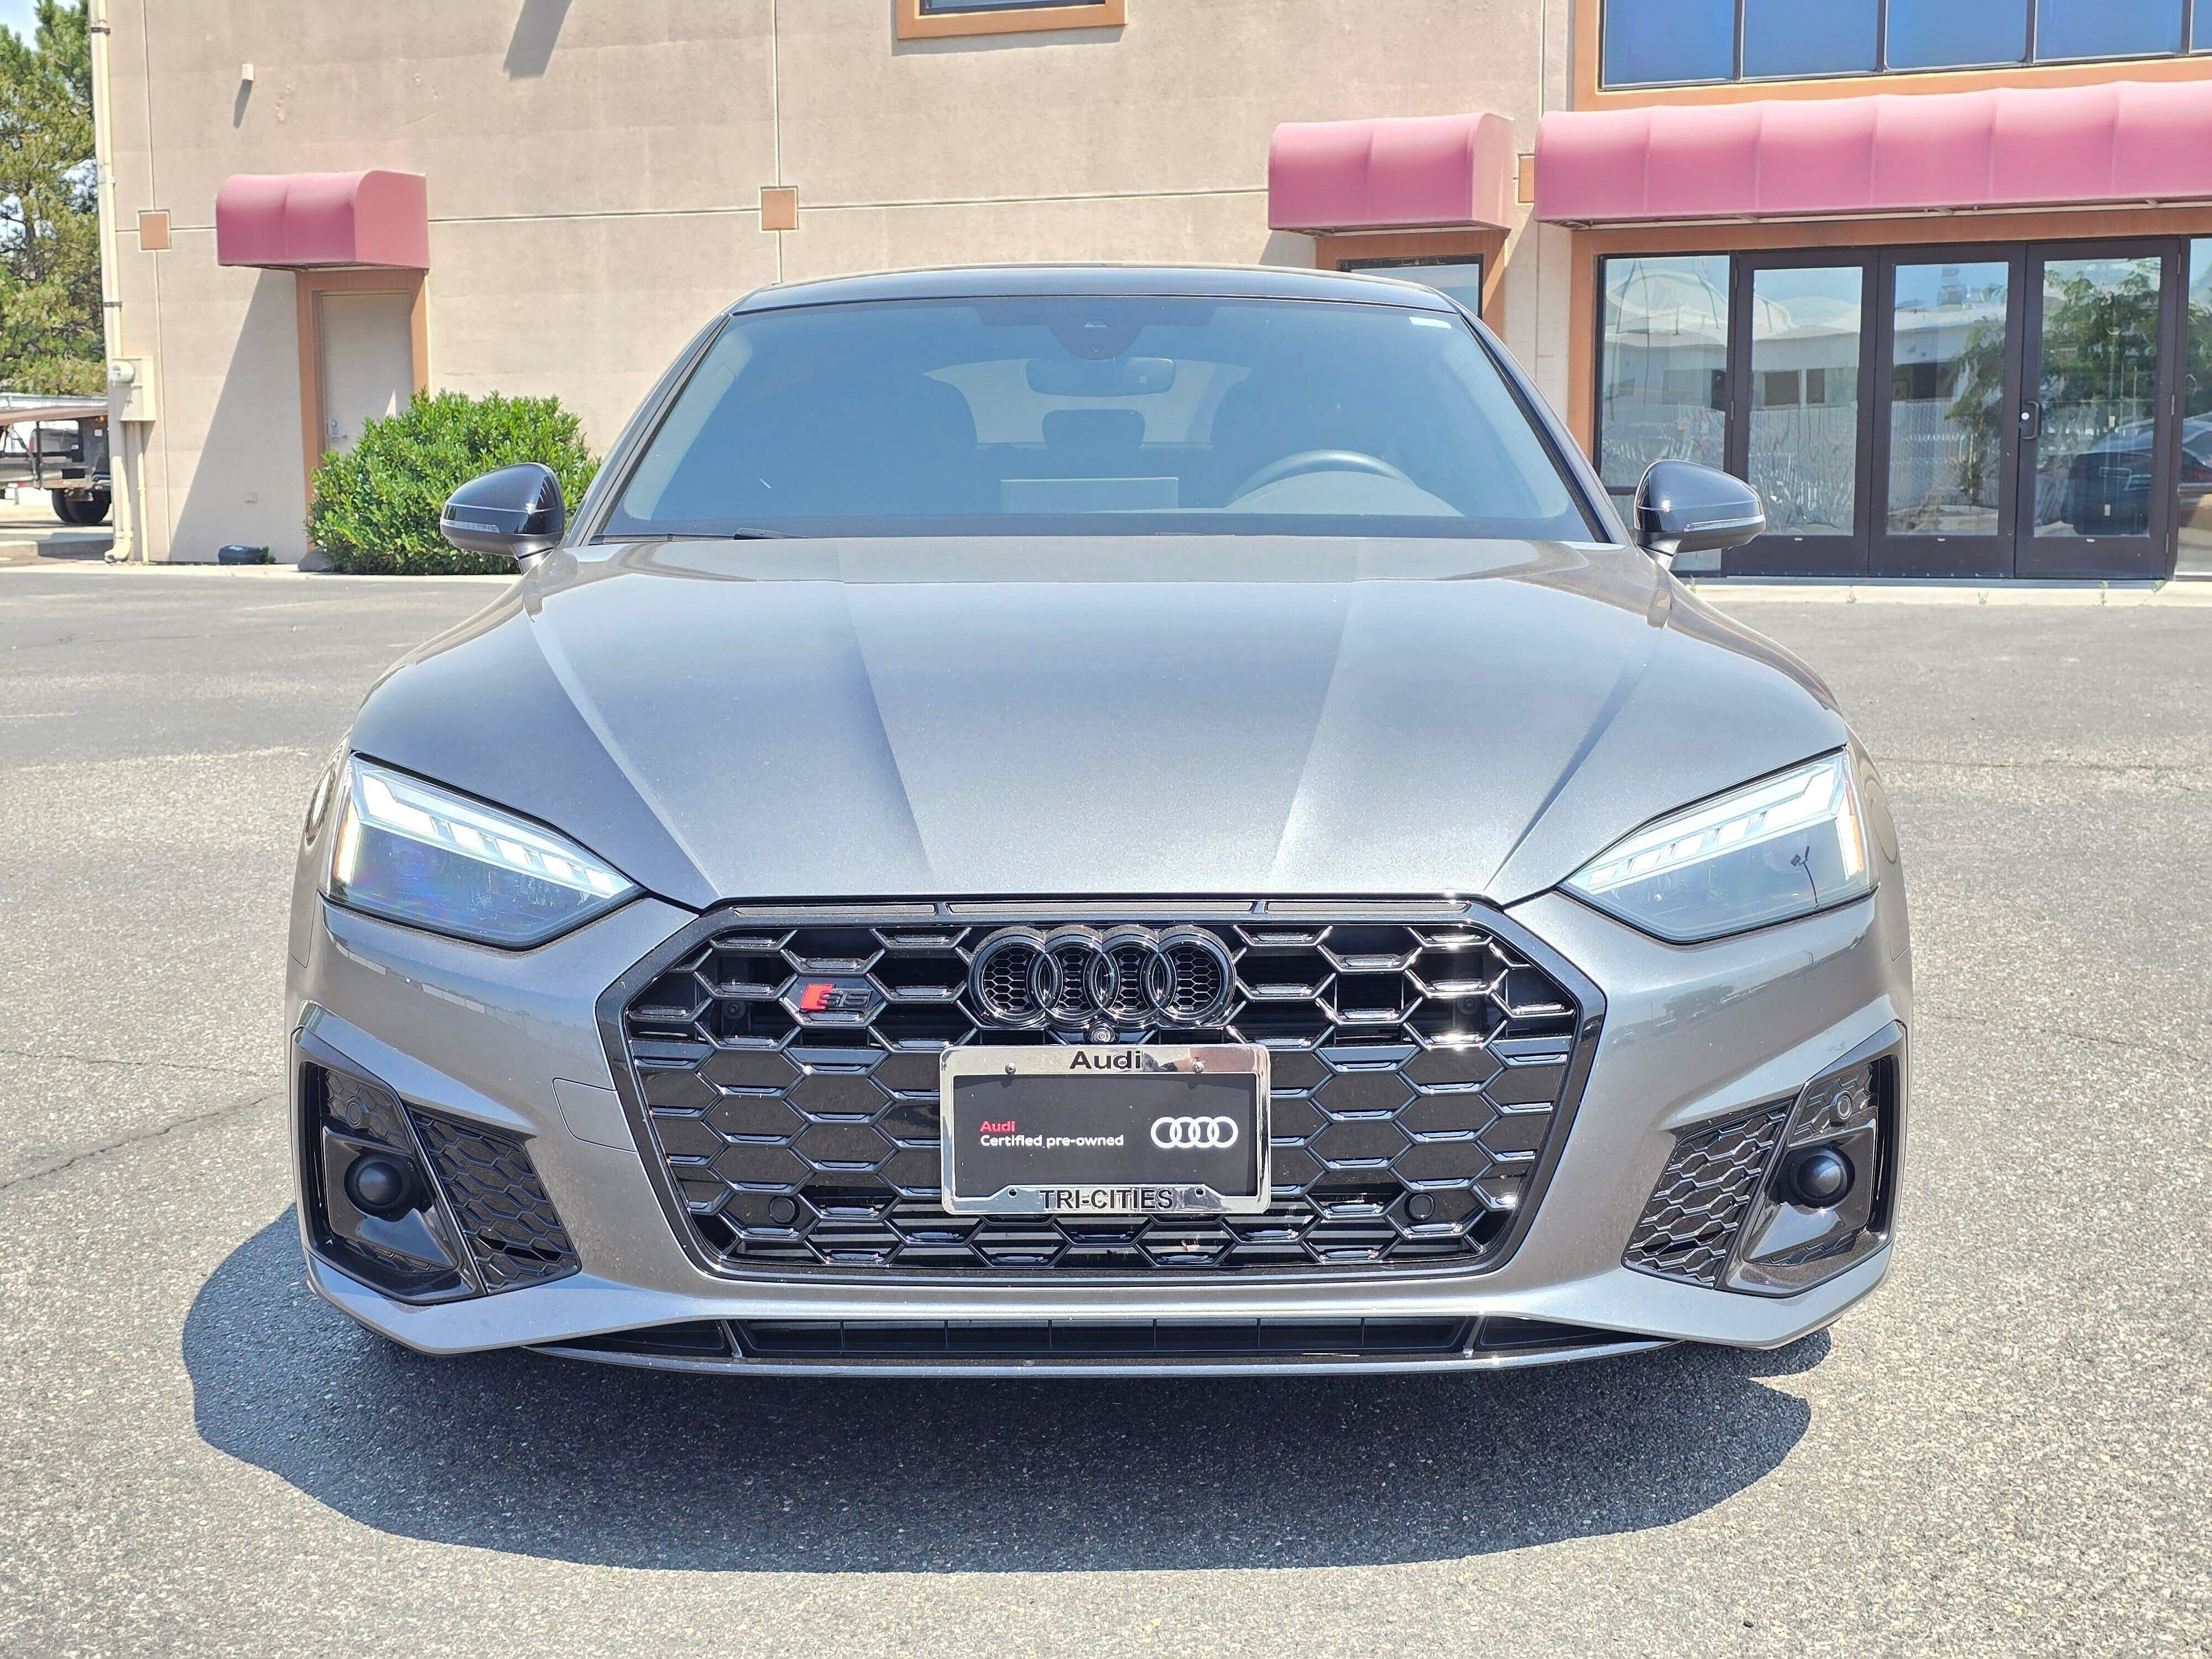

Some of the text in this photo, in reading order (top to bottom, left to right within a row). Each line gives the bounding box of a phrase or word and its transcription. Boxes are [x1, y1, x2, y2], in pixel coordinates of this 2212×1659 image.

[1069, 1050, 1141, 1070] Audi
[980, 1120, 1016, 1132] Audi
[980, 1135, 1124, 1149] Certified pre-owned
[1039, 1189, 1173, 1209] TRI-CITIES
